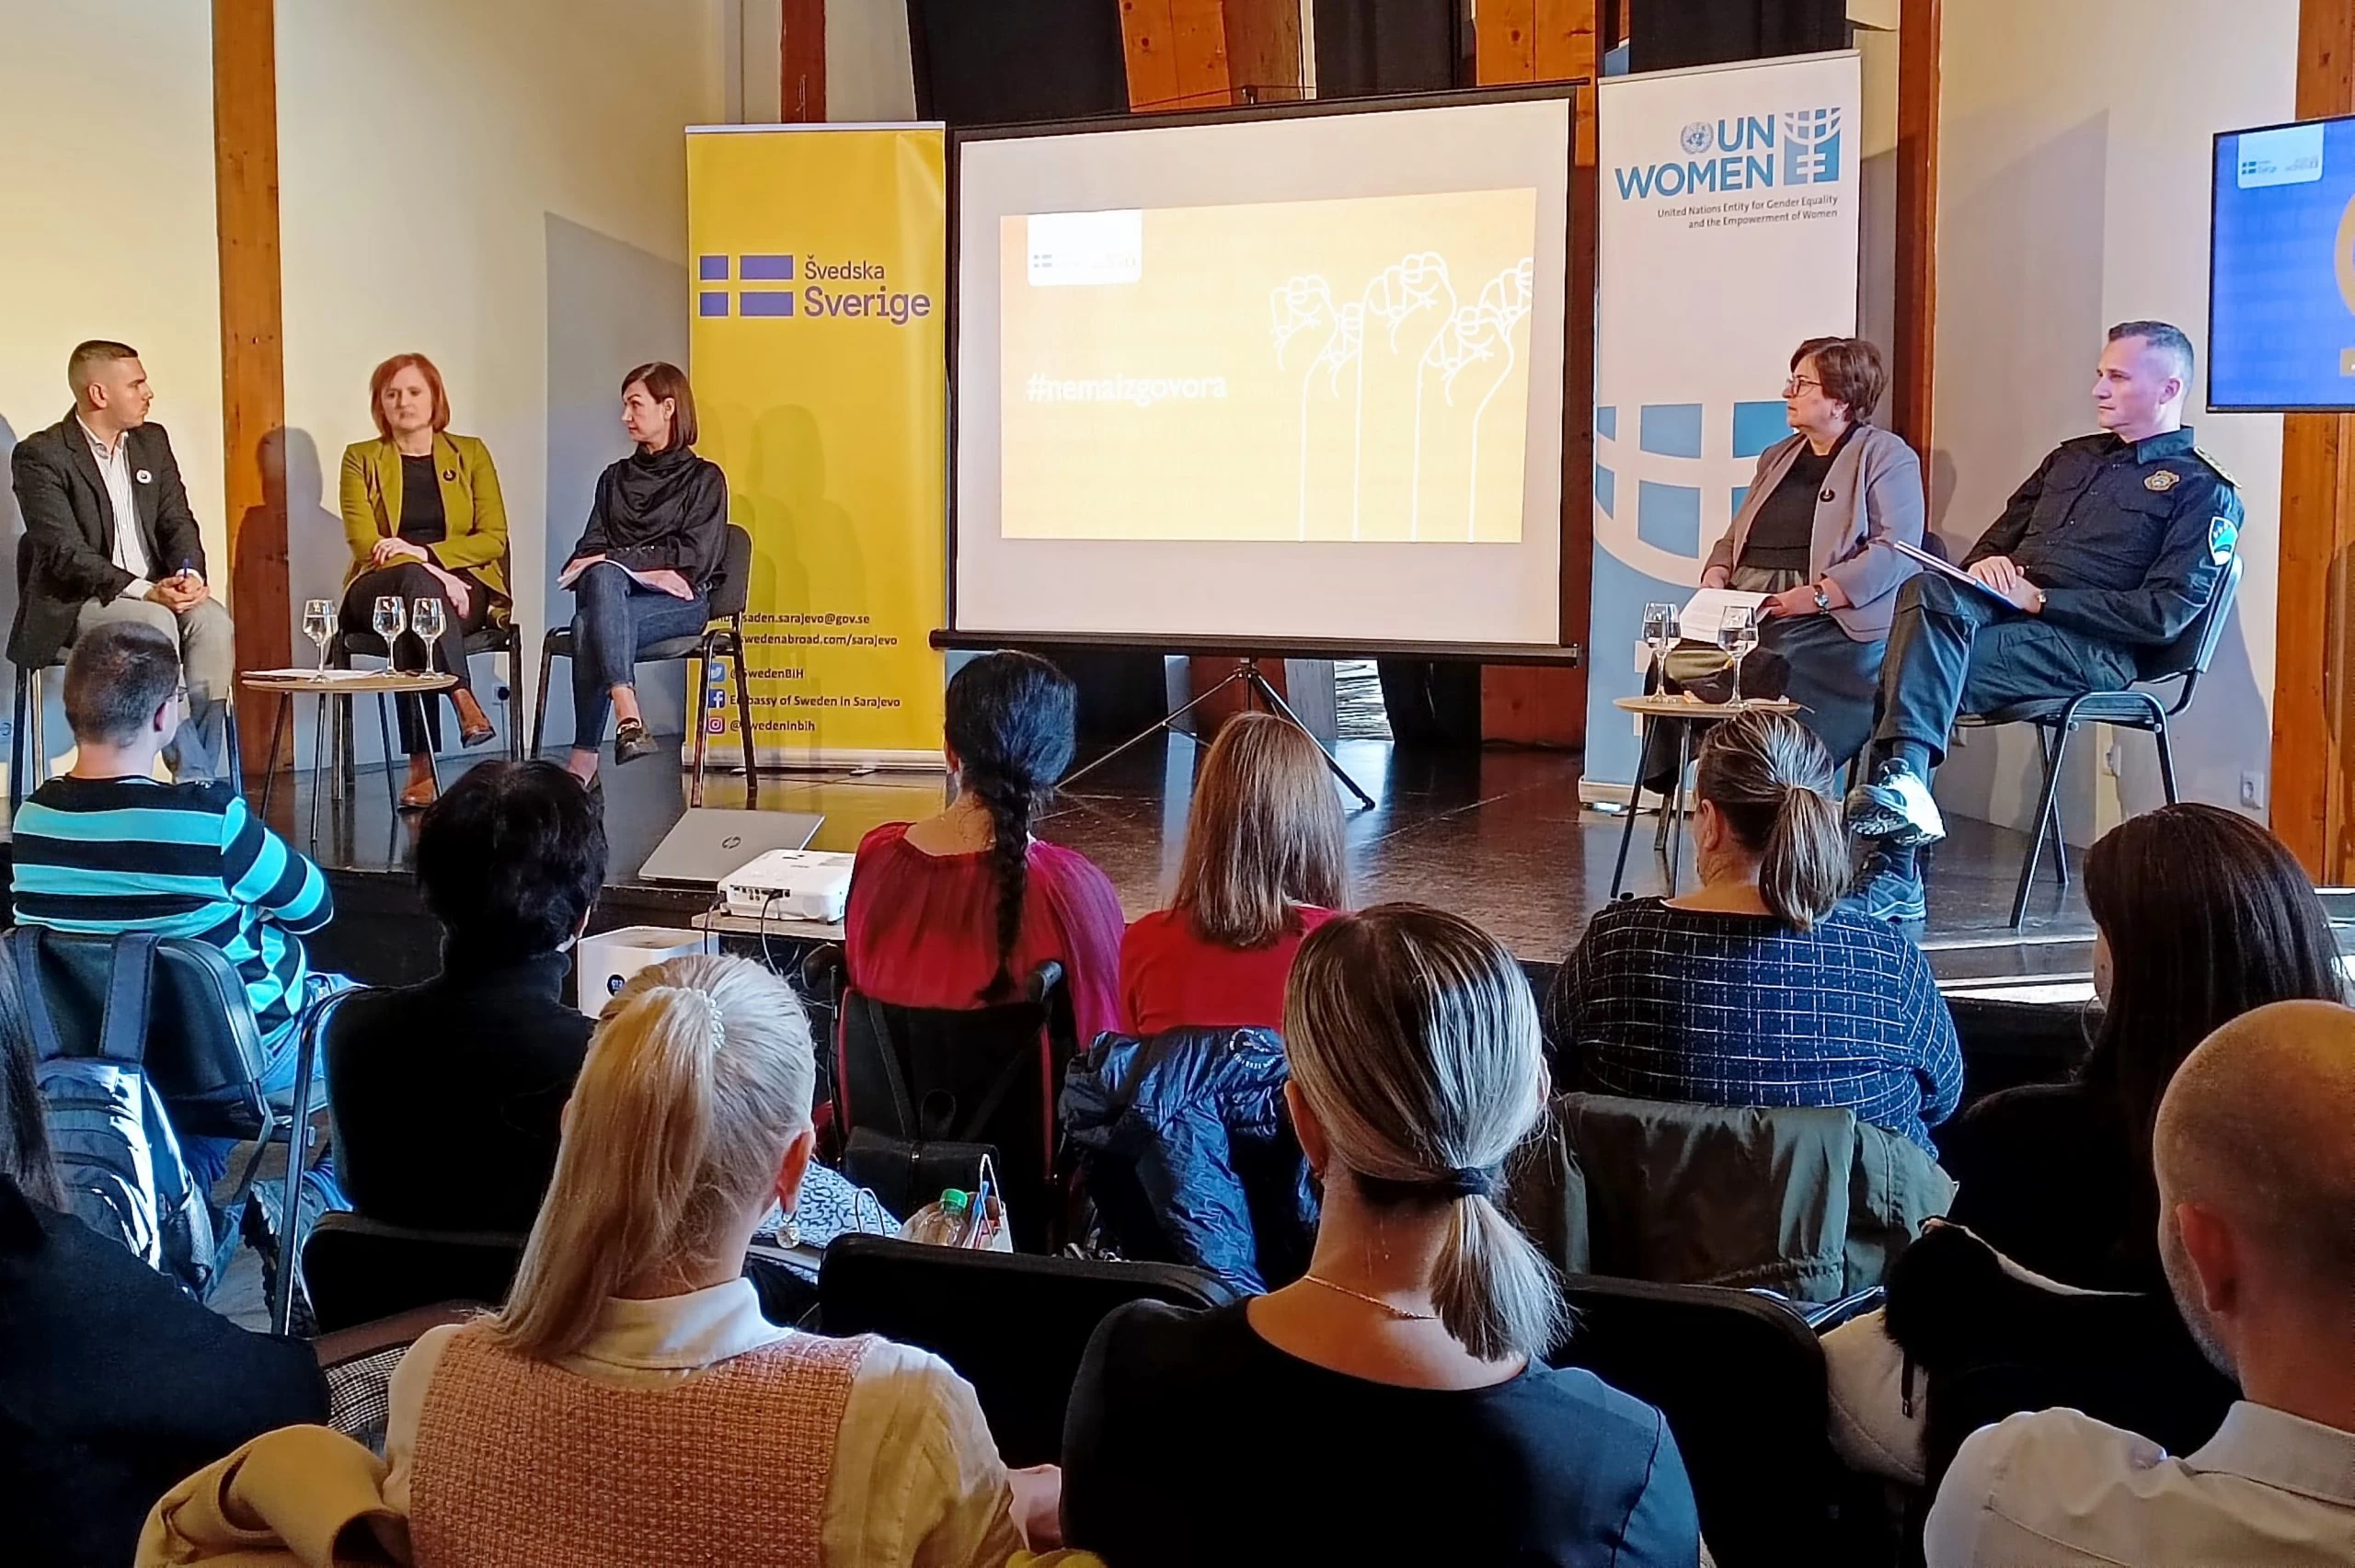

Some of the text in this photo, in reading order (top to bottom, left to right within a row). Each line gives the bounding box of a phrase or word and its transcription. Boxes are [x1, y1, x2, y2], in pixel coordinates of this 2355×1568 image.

[1717, 114, 1775, 153] UN
[1614, 153, 1775, 200] WOMEN
[1657, 195, 1838, 218] United Nations Entity for Gender Equality
[1688, 210, 1838, 228] and the Empowerment of Women
[804, 254, 885, 280] Švedska
[804, 285, 931, 326] Sverige
[1026, 372, 1229, 407] #nemaizgovora
[741, 634, 898, 647] wedenabroad.com/sarajevo
[729, 695, 776, 708] Ebassy
[779, 695, 791, 705] of
[795, 696, 836, 707] Sweden
[853, 696, 901, 708] Sarajevo
[729, 719, 815, 732] @wedeninbih
